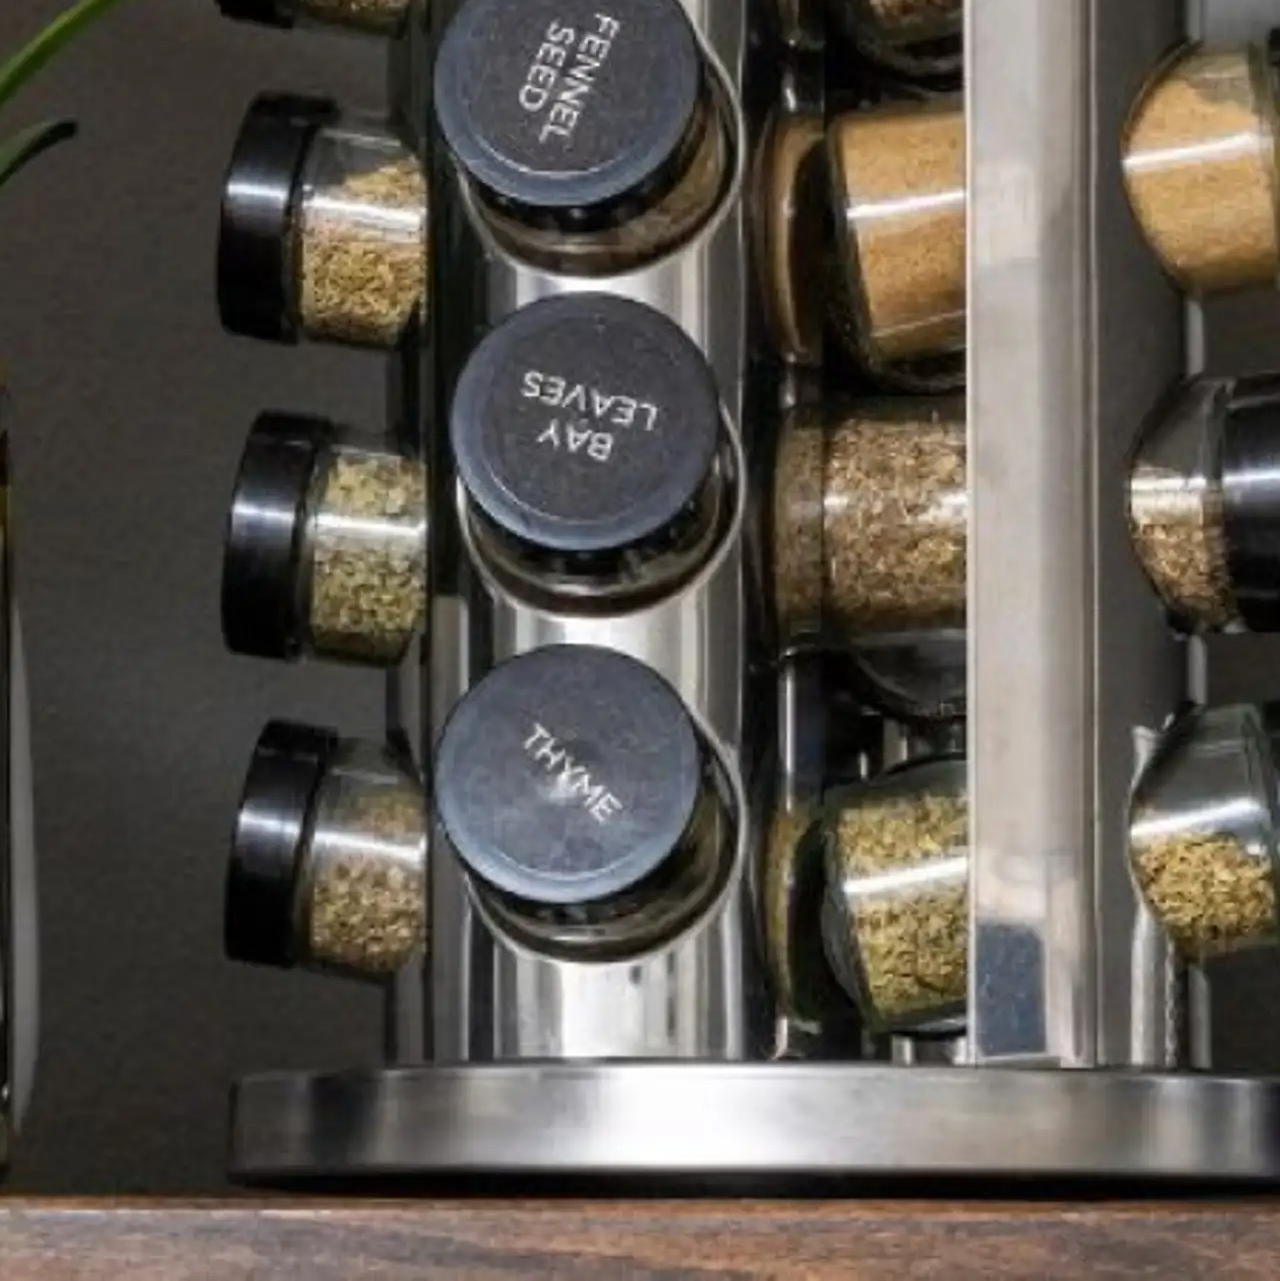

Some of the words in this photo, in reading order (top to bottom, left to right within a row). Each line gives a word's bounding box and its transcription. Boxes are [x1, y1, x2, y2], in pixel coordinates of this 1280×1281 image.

[519, 20, 575, 112] SEED
[538, 12, 620, 144] FENNEL
[520, 370, 658, 431] LEAVES
[536, 418, 614, 462] BAY
[523, 721, 623, 824] THYME
